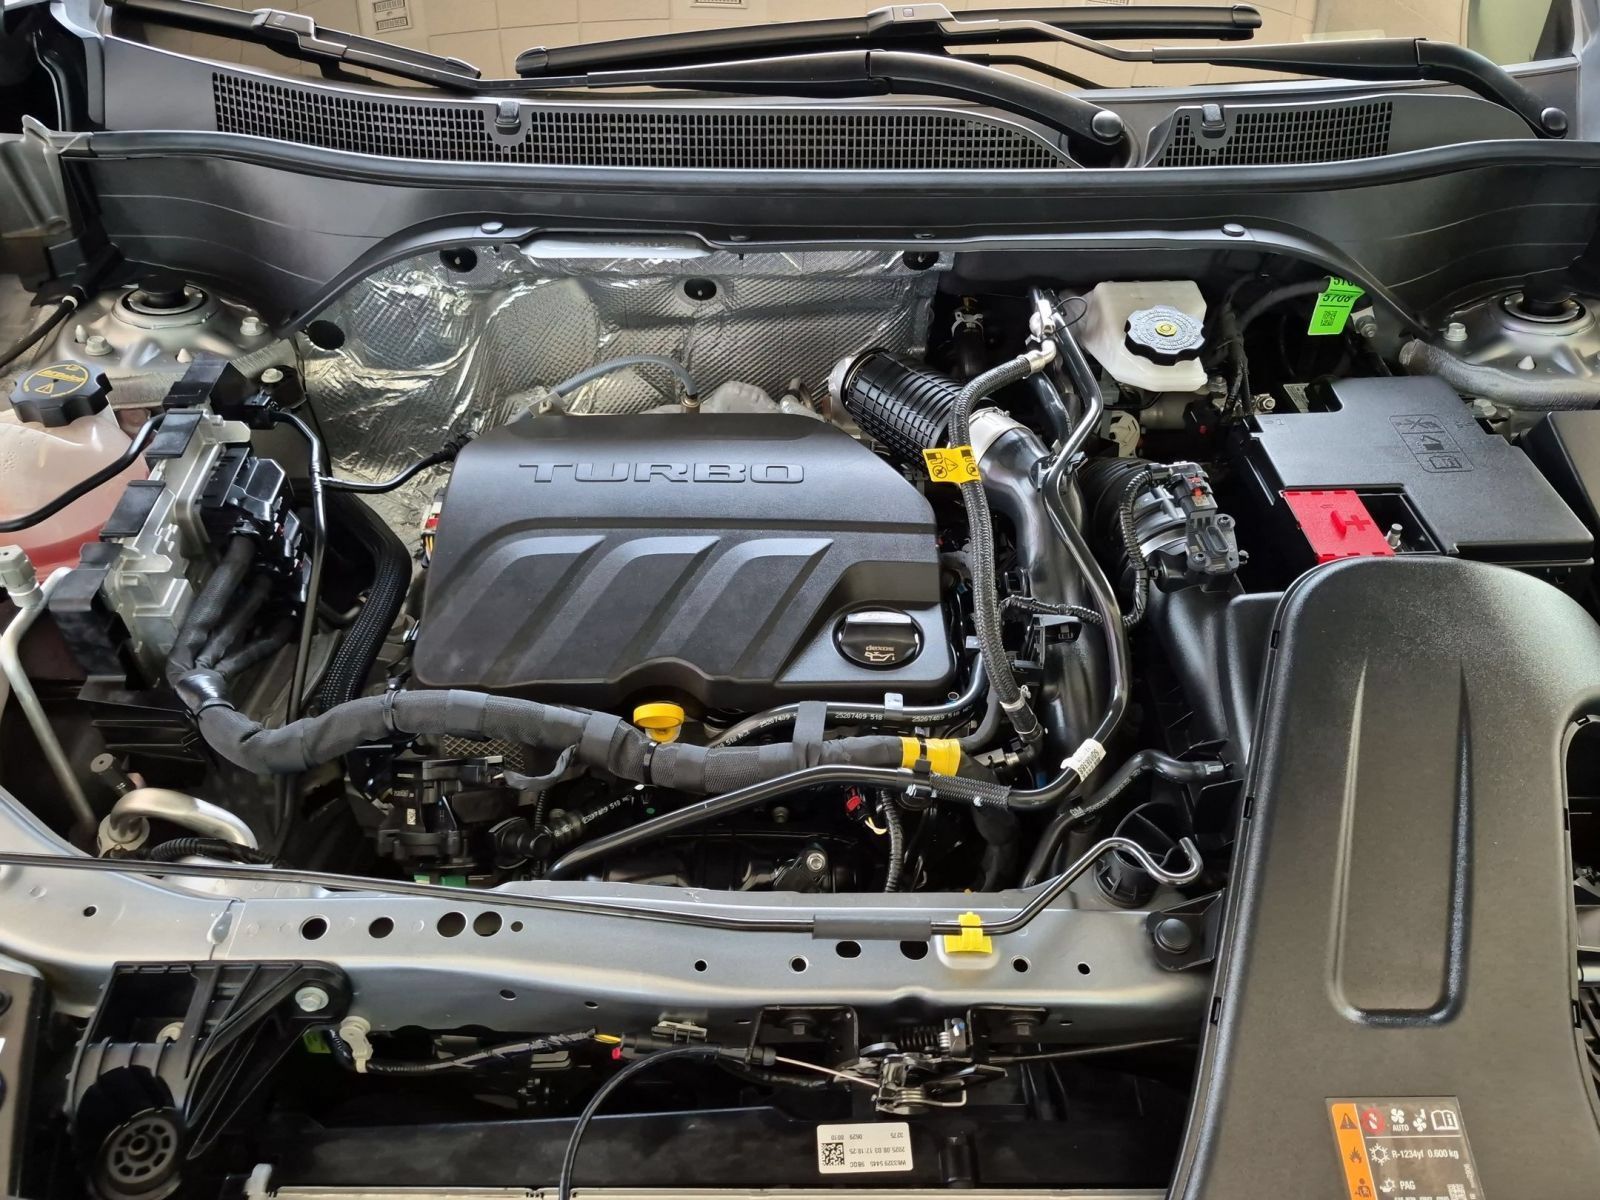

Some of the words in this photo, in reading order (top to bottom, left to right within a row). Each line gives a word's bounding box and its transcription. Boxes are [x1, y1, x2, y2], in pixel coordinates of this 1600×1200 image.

[519, 462, 804, 483] TURBO
[1392, 1124, 1410, 1132] AUTO
[1428, 1149, 1448, 1158] 0.600
[1449, 1149, 1459, 1159] kg
[1400, 1180, 1416, 1190] PAG
